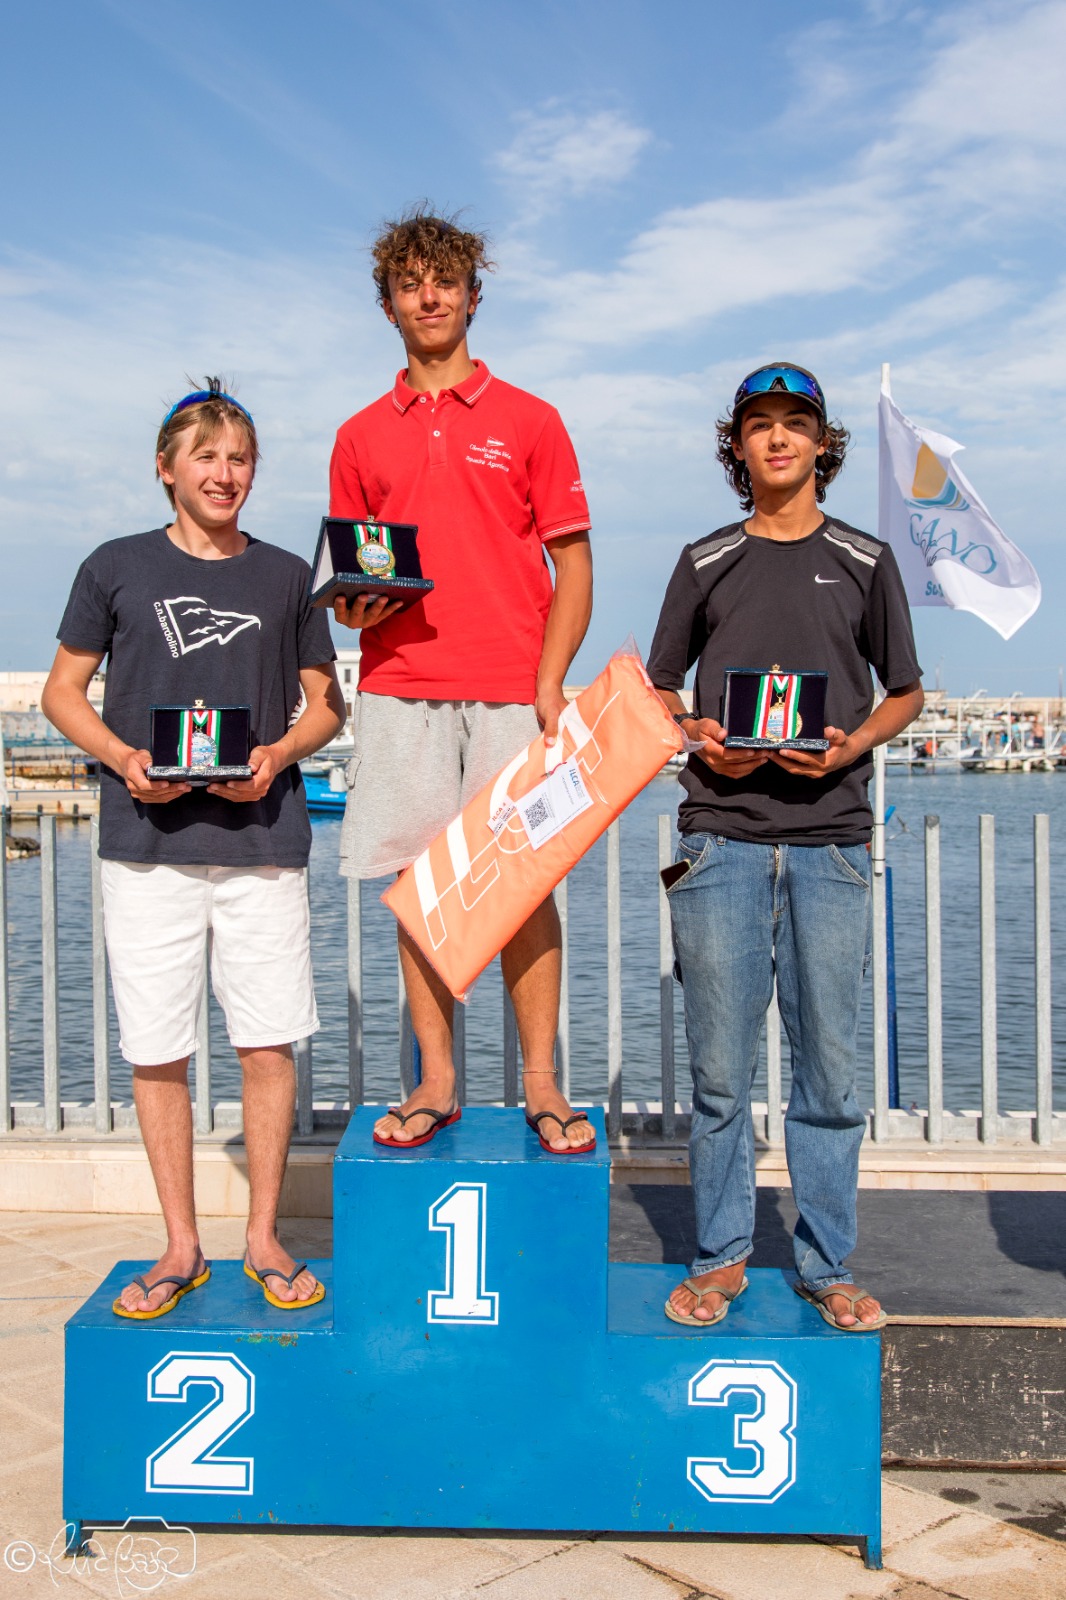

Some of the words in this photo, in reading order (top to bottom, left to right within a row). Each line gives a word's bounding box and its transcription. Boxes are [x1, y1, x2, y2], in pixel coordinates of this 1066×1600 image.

[153, 601, 180, 659] c.n.bardolino
[492, 807, 503, 821] ILCA
[569, 768, 580, 787] ILCA
[426, 1181, 500, 1325] 1
[145, 1350, 256, 1496] 2
[686, 1358, 798, 1504] 3
